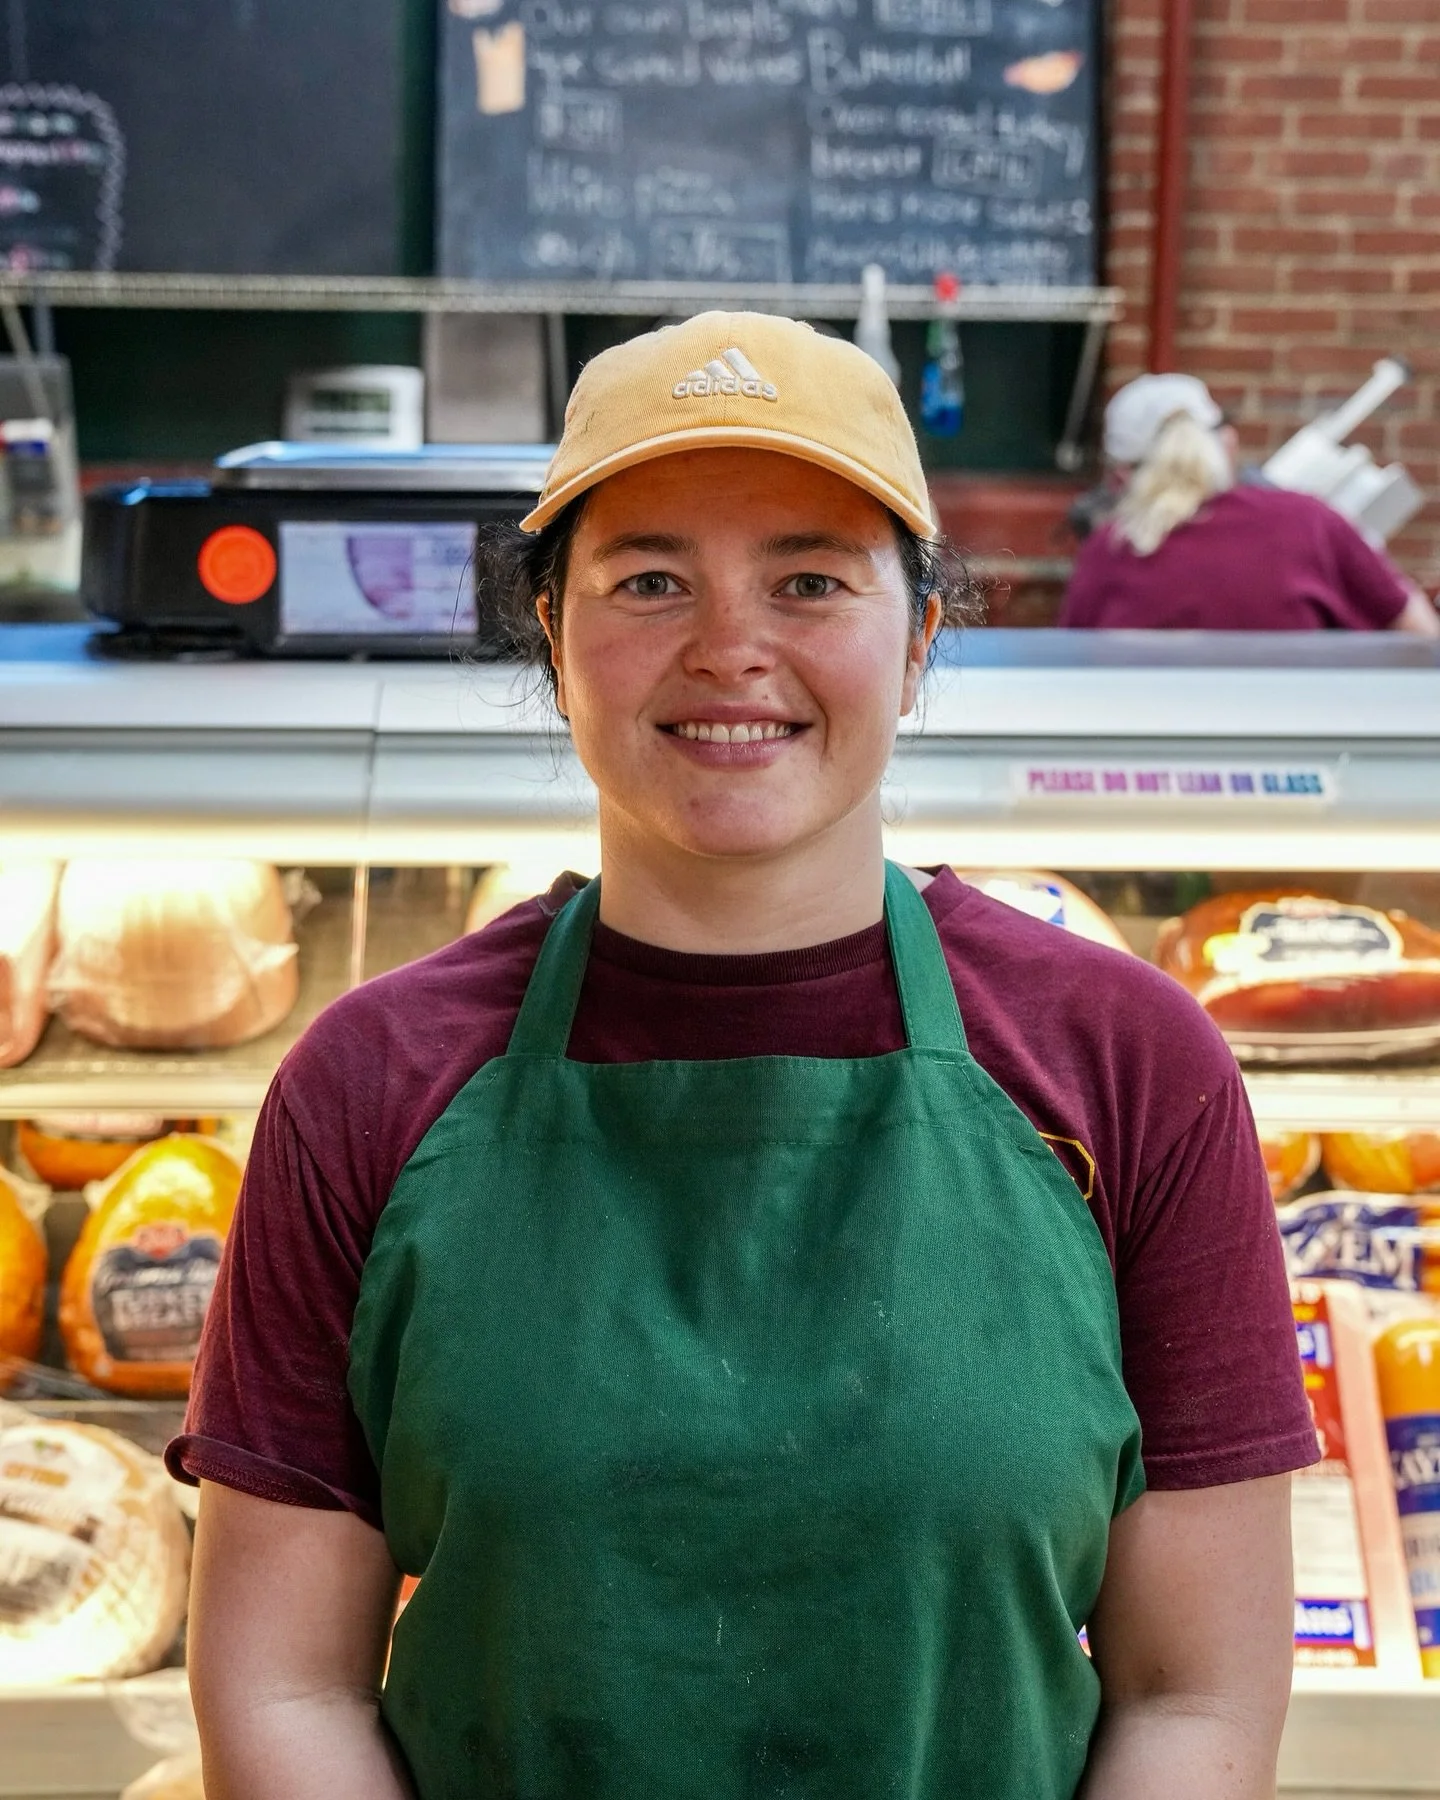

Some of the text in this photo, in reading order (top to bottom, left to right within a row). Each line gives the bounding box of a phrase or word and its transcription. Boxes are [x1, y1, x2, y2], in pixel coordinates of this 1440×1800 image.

[672, 377, 778, 400] adidas
[1028, 771, 1096, 791] PLEASE
[1103, 772, 1127, 791] DO
[1136, 772, 1170, 792] NOT
[1262, 774, 1323, 793] GLASS
